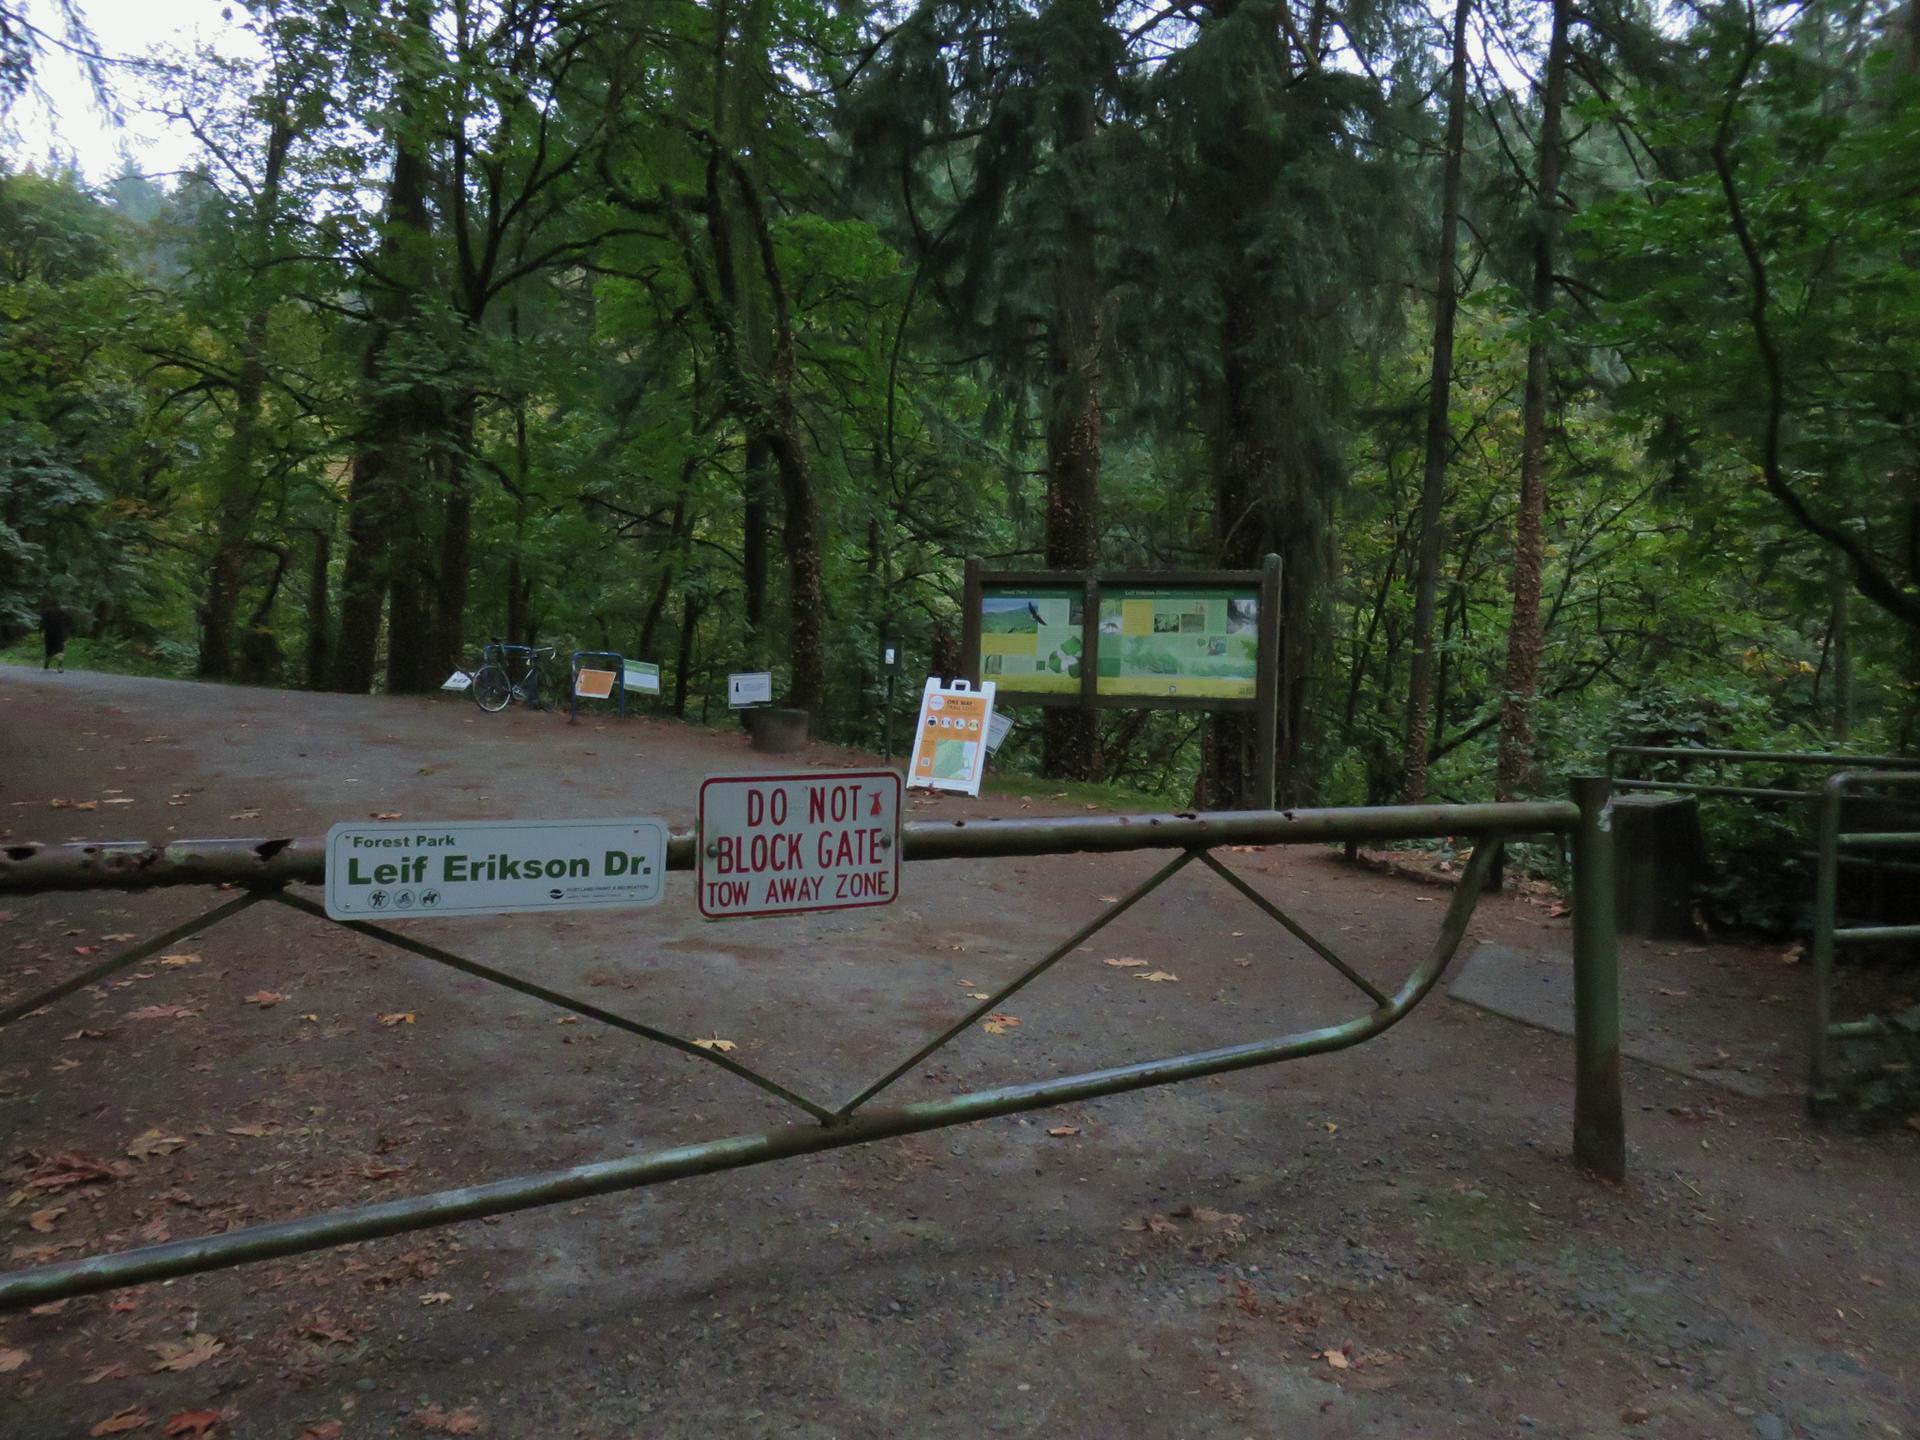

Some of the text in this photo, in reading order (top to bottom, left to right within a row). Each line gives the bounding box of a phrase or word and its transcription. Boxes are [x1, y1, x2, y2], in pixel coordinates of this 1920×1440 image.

[747, 785, 862, 827] DO NOT
[353, 834, 456, 849] Forest Park
[717, 828, 882, 874] BLOCK GATE
[348, 850, 651, 885] Leif Erikson Dr.
[707, 871, 889, 908] TOW AWAY ZONE
